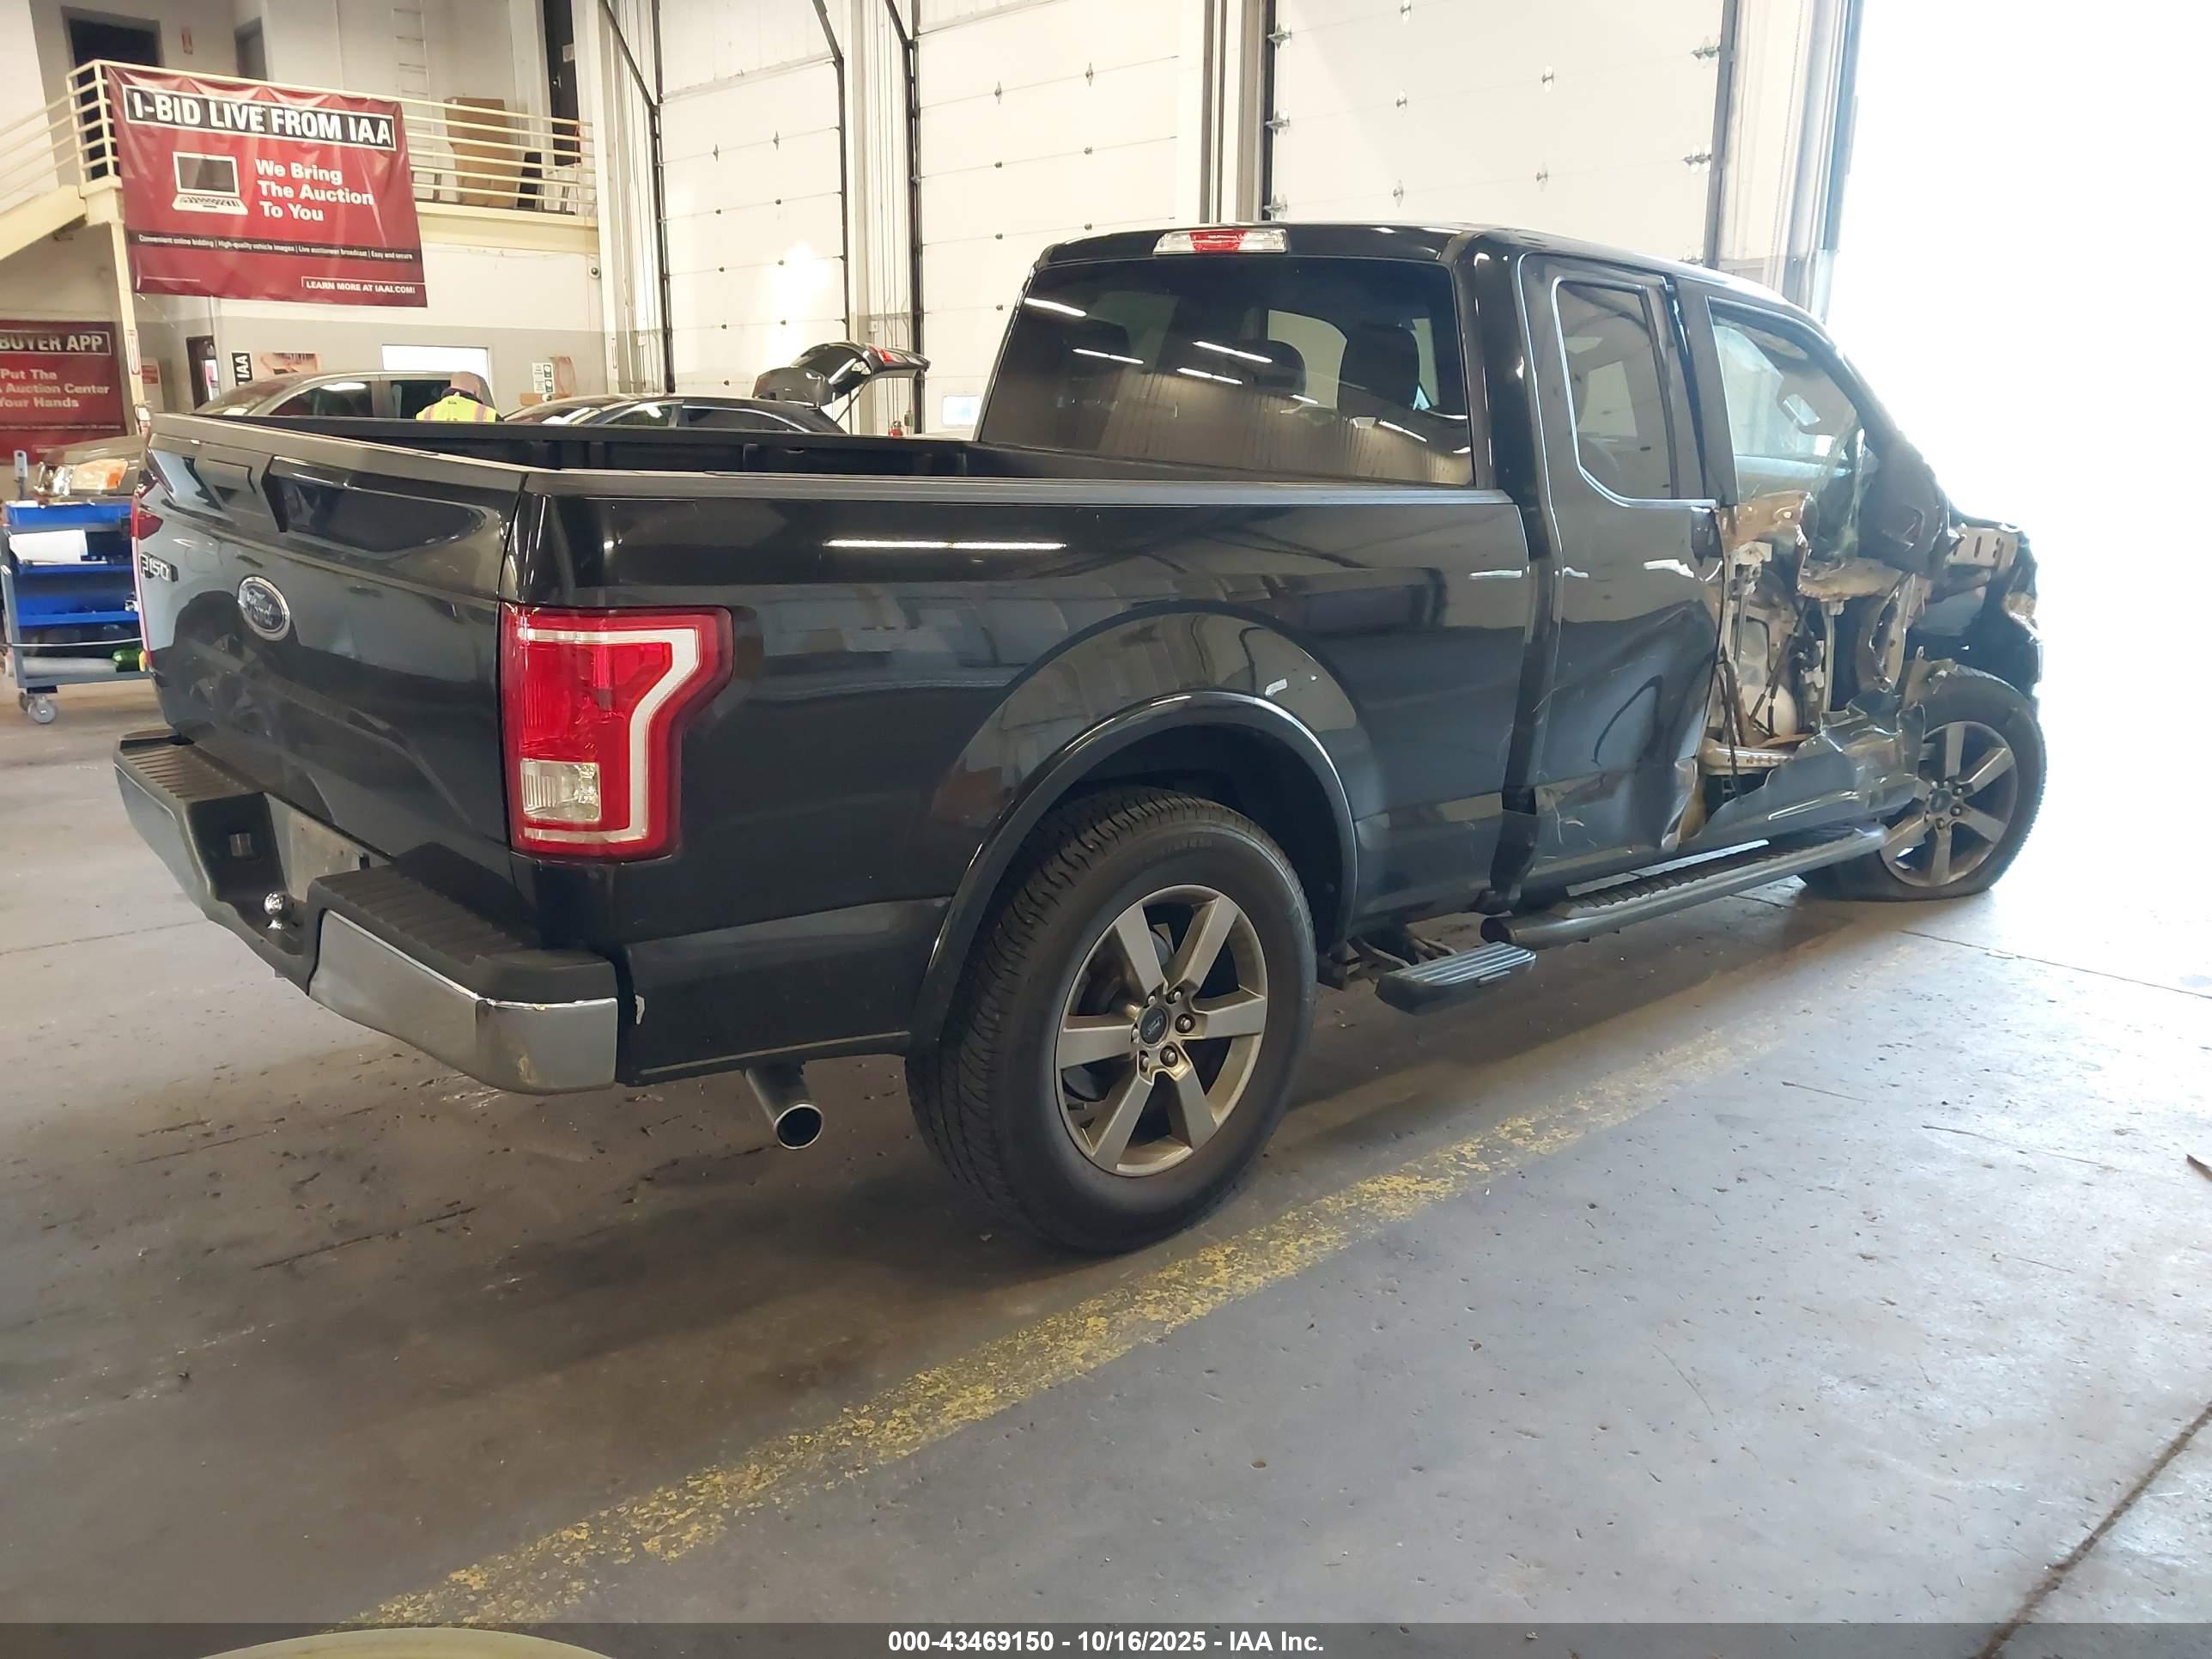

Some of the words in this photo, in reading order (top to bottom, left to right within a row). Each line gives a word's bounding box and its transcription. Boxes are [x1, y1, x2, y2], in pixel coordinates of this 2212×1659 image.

[133, 92, 201, 125] I-BID
[209, 101, 265, 132] LIVE
[270, 107, 343, 140] FROM
[348, 117, 392, 145] IAA
[255, 158, 286, 178] We
[290, 161, 343, 186] Bring
[257, 179, 295, 198] The
[299, 184, 374, 206] Auction
[258, 200, 283, 218] To
[287, 203, 325, 222] You
[306, 281, 336, 290] LEARN
[337, 283, 362, 292] MORE
[66, 335, 103, 351] APP
[0, 368, 26, 380] Put
[30, 368, 58, 380] The
[6, 383, 61, 394] Auction
[64, 383, 111, 394] Center
[33, 397, 80, 408] Hands
